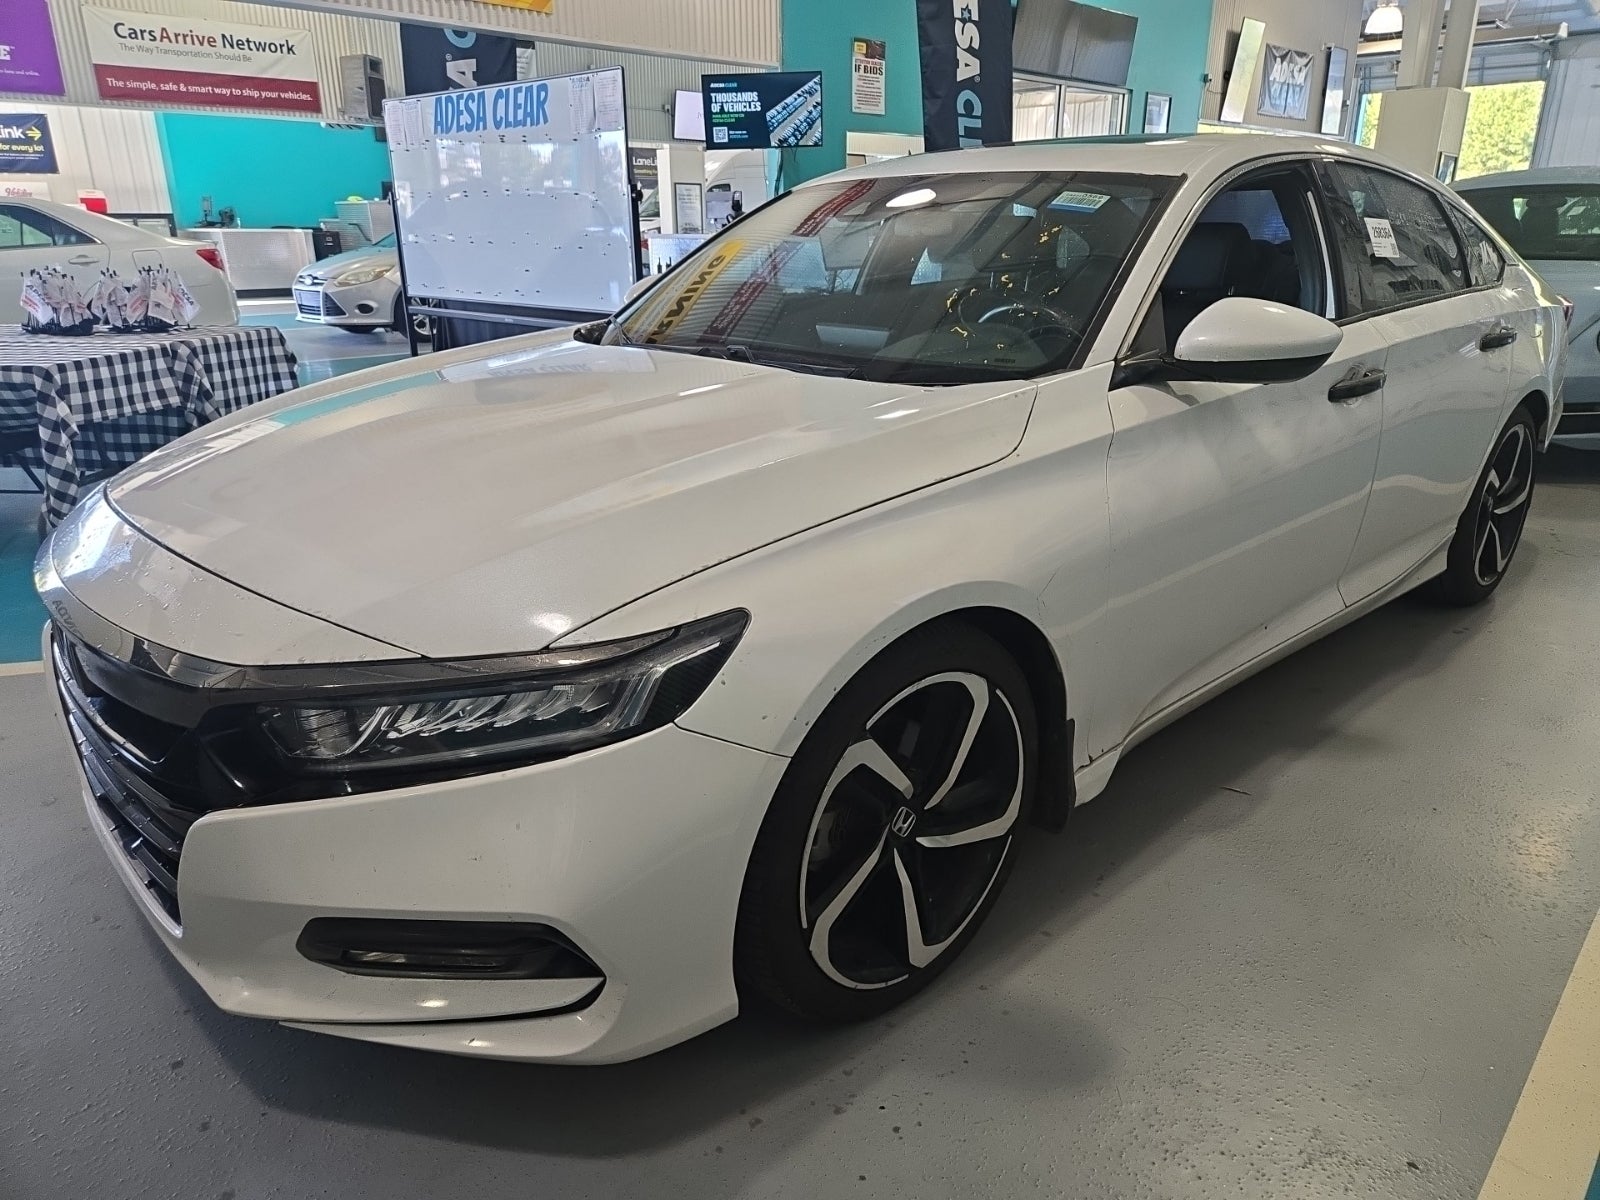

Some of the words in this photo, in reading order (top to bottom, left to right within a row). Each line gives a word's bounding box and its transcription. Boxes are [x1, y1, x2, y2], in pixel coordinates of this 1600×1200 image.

[118, 42, 136, 52] The
[136, 45, 154, 55] Way
[155, 46, 213, 59] Transportation
[214, 51, 241, 62] Should
[242, 54, 253, 62] Be
[221, 33, 297, 56] Network
[854, 63, 862, 74] IF
[863, 64, 884, 76] BIDS
[106, 77, 125, 88] The
[126, 79, 159, 91] simple,
[160, 82, 178, 92] safe
[180, 83, 187, 92] &
[188, 85, 213, 94] smart
[213, 87, 231, 97] way
[232, 87, 241, 95] to
[242, 88, 260, 98] ship
[260, 90, 279, 99] your
[280, 91, 313, 101] vehicles.
[710, 91, 759, 103] THOUSANDS
[433, 90, 487, 135] ADESA
[492, 82, 549, 131] CLEAR
[711, 103, 722, 113] OF
[722, 101, 762, 113] VEHICLES
[11, 144, 33, 154] every
[34, 144, 45, 152] lot
